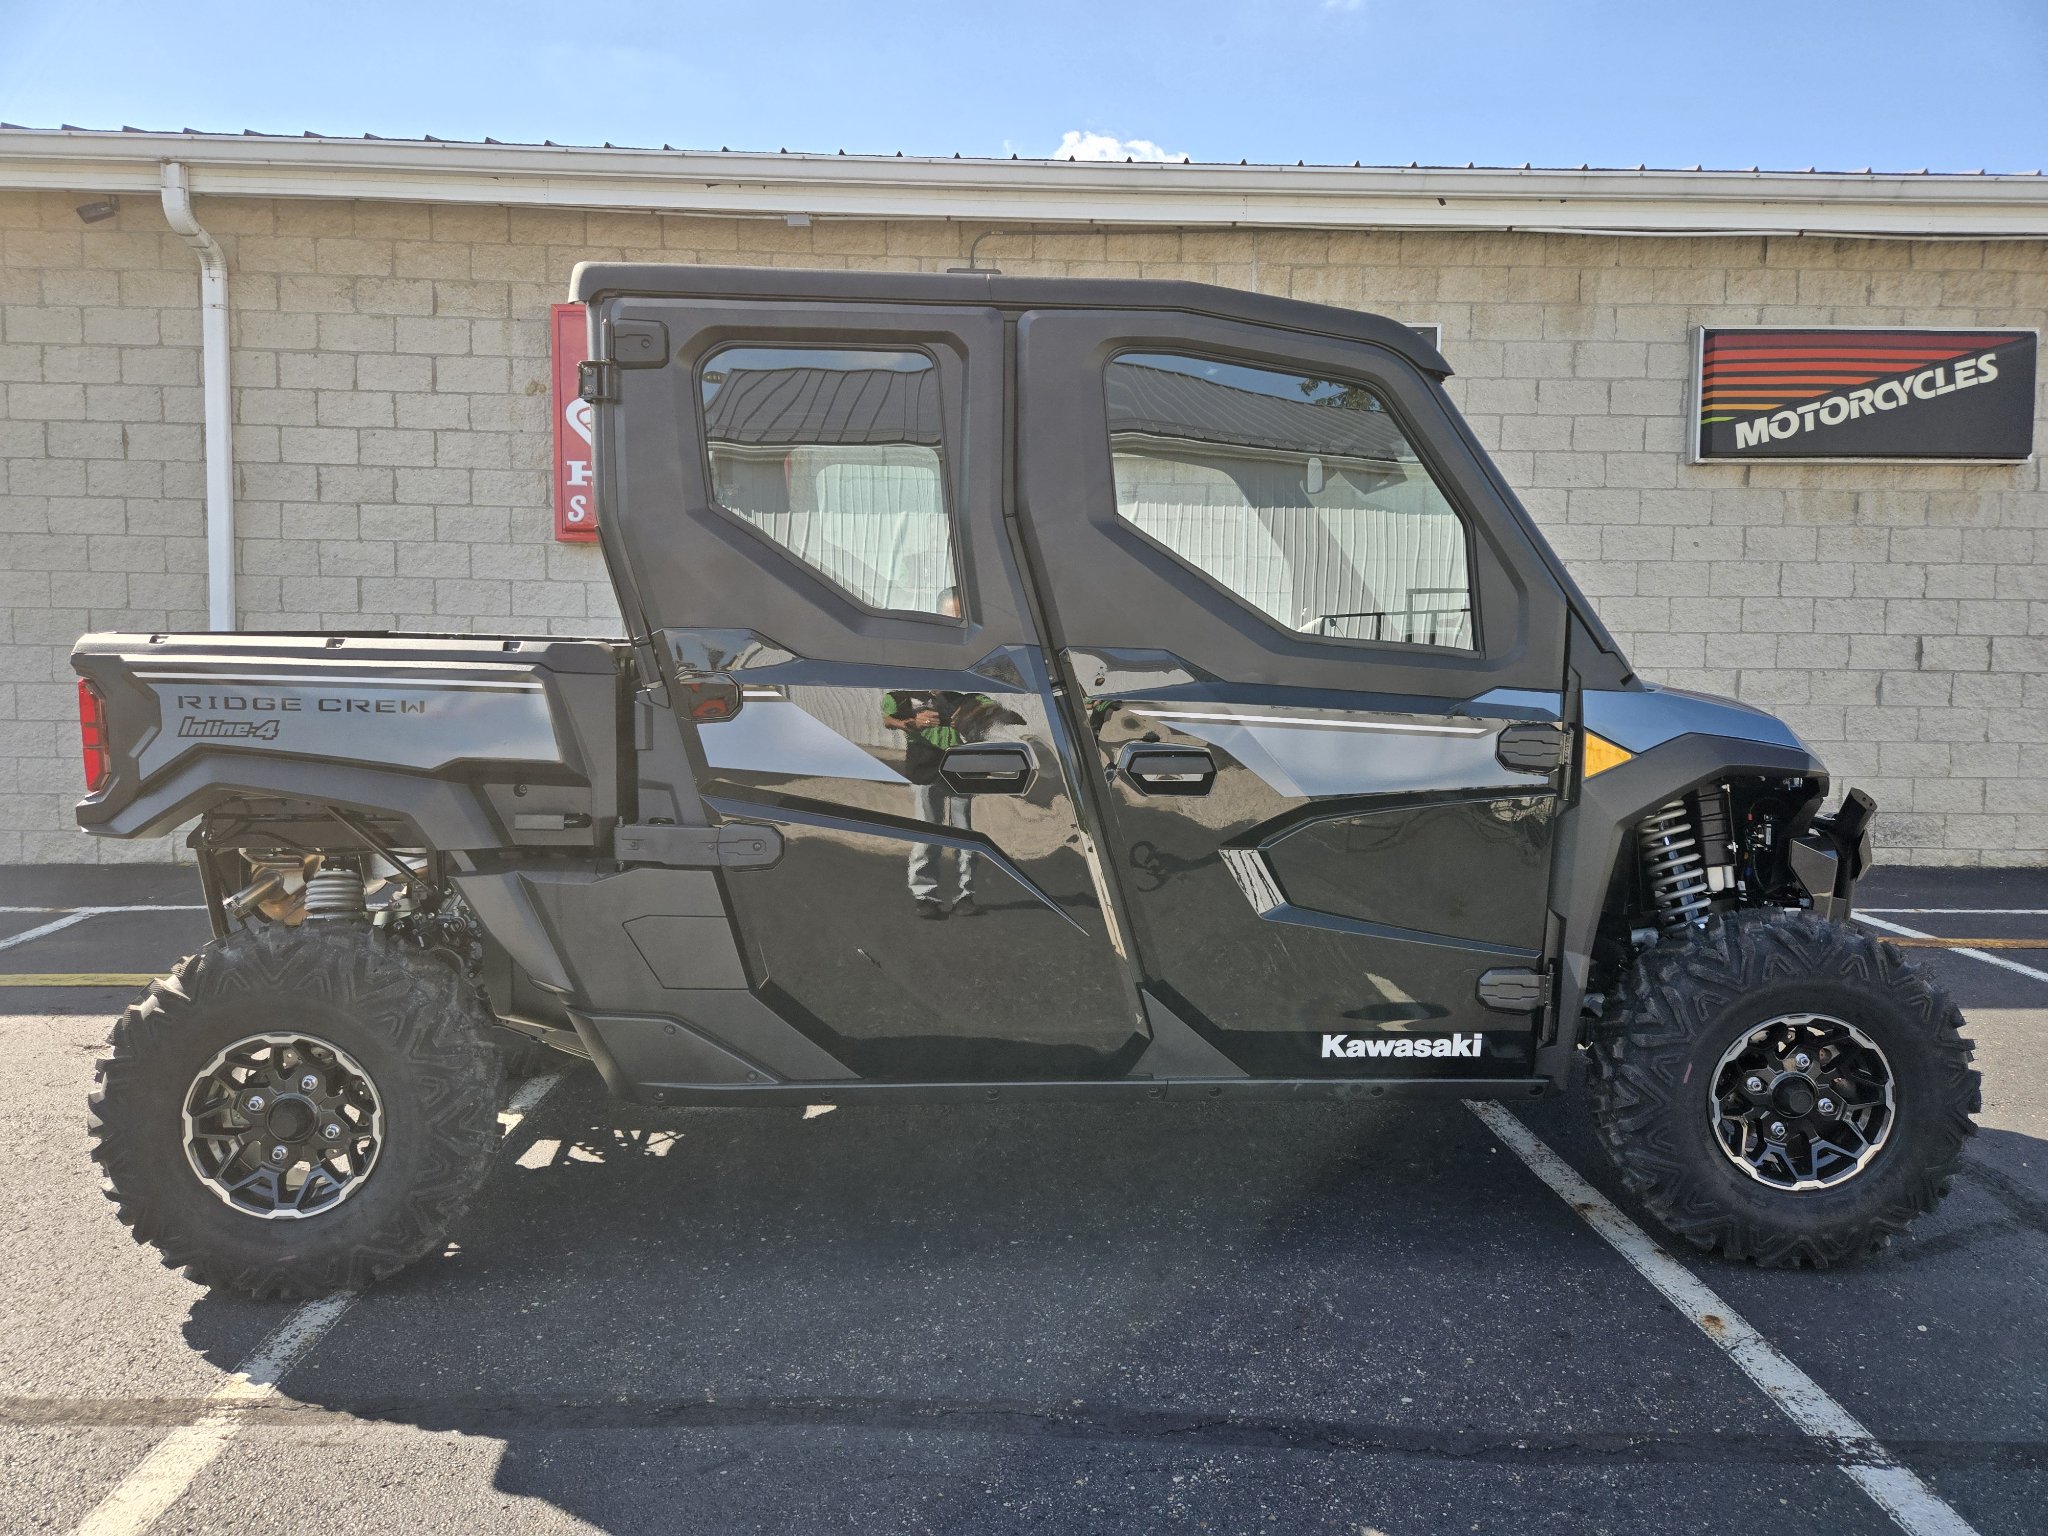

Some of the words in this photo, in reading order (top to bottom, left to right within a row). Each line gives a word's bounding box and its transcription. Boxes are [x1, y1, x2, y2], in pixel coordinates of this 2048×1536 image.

[1734, 352, 2000, 450] MOTORCYCLES
[177, 695, 302, 711] RIDGE
[318, 698, 426, 714] CREW
[177, 716, 281, 741] Inline-4
[1321, 1033, 1483, 1058] Kawasaki
